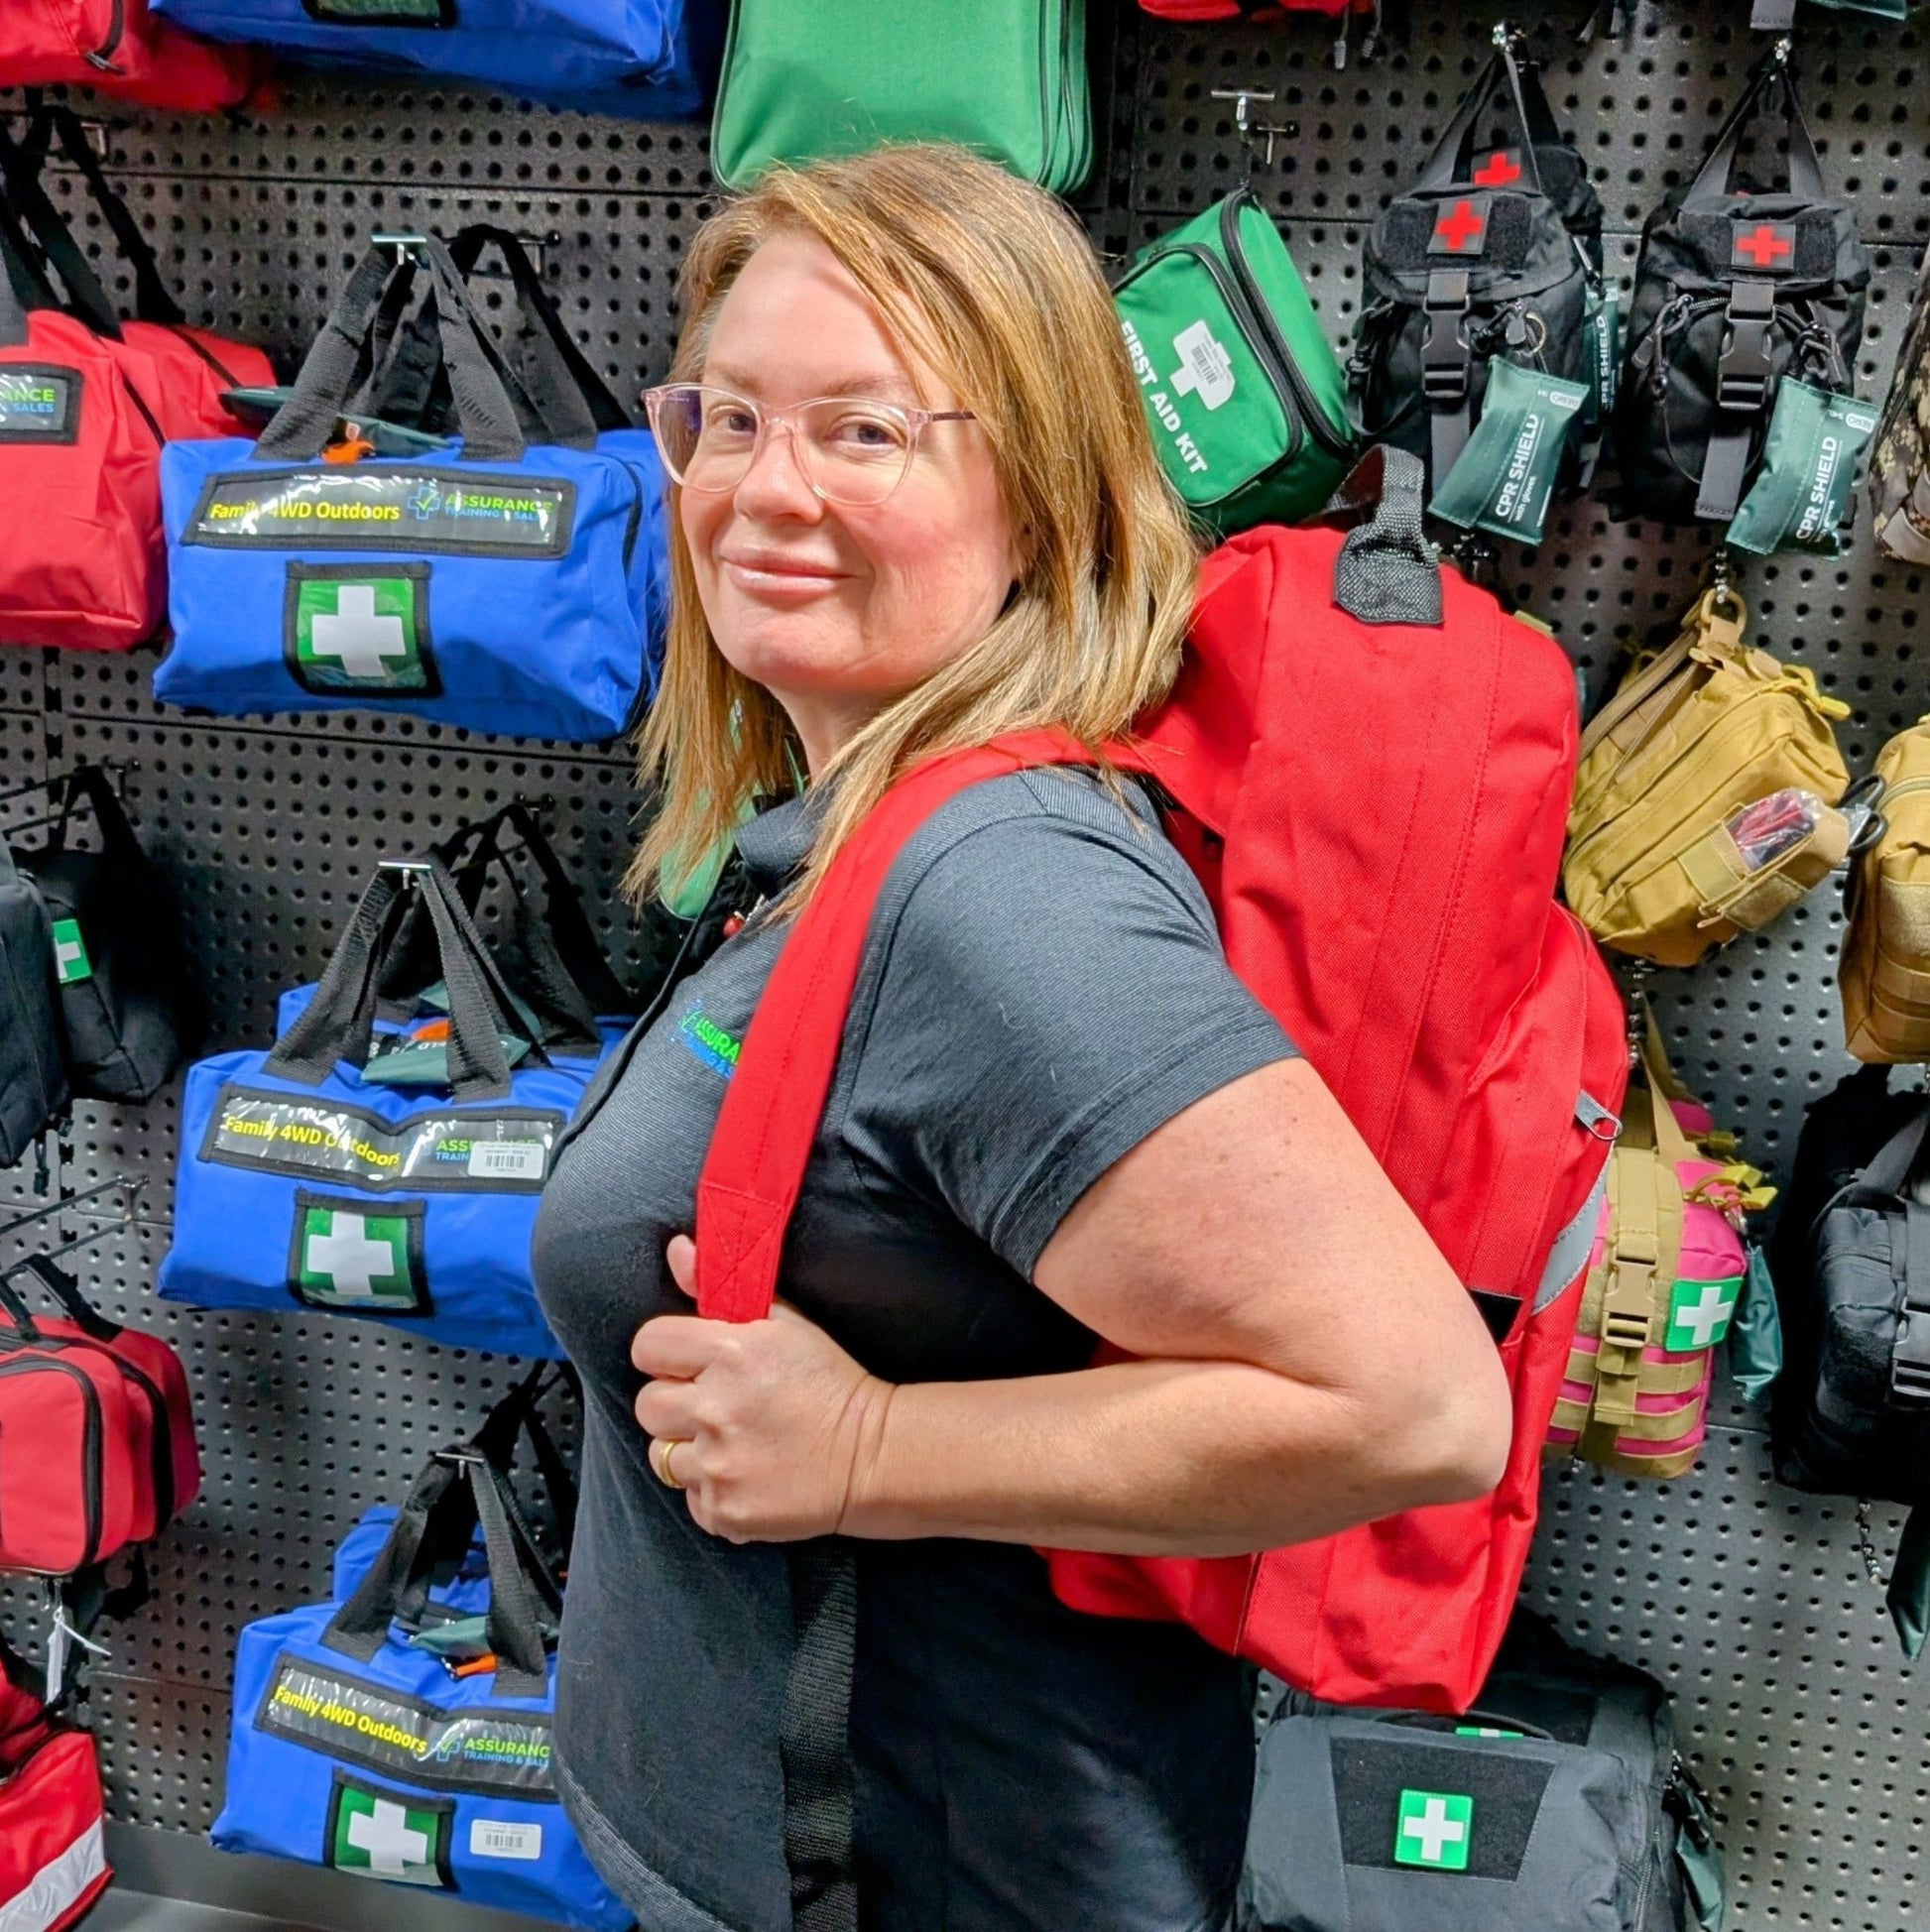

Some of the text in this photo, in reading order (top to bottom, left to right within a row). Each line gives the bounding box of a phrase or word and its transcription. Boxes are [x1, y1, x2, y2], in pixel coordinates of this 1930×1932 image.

[1596, 315, 1609, 377] SHIELD
[14, 403, 55, 414] SALES
[1122, 320, 1208, 474] FIRST AID KIT
[1495, 413, 1540, 518] CPR SHIELD
[1796, 506, 1820, 540] CPR
[1810, 435, 1837, 505] SHIELD
[316, 502, 400, 520] Outdoors
[514, 511, 542, 523] SAL
[1514, 475, 1536, 522] with gloves
[694, 1017, 740, 1065] ASSURA
[224, 1116, 278, 1142] Family
[280, 1124, 322, 1146] 4WD
[275, 1686, 427, 1753] Family 4WD Outdoors
[464, 1737, 550, 1758] ASSURANC
[464, 1750, 514, 1763] TRAINING
